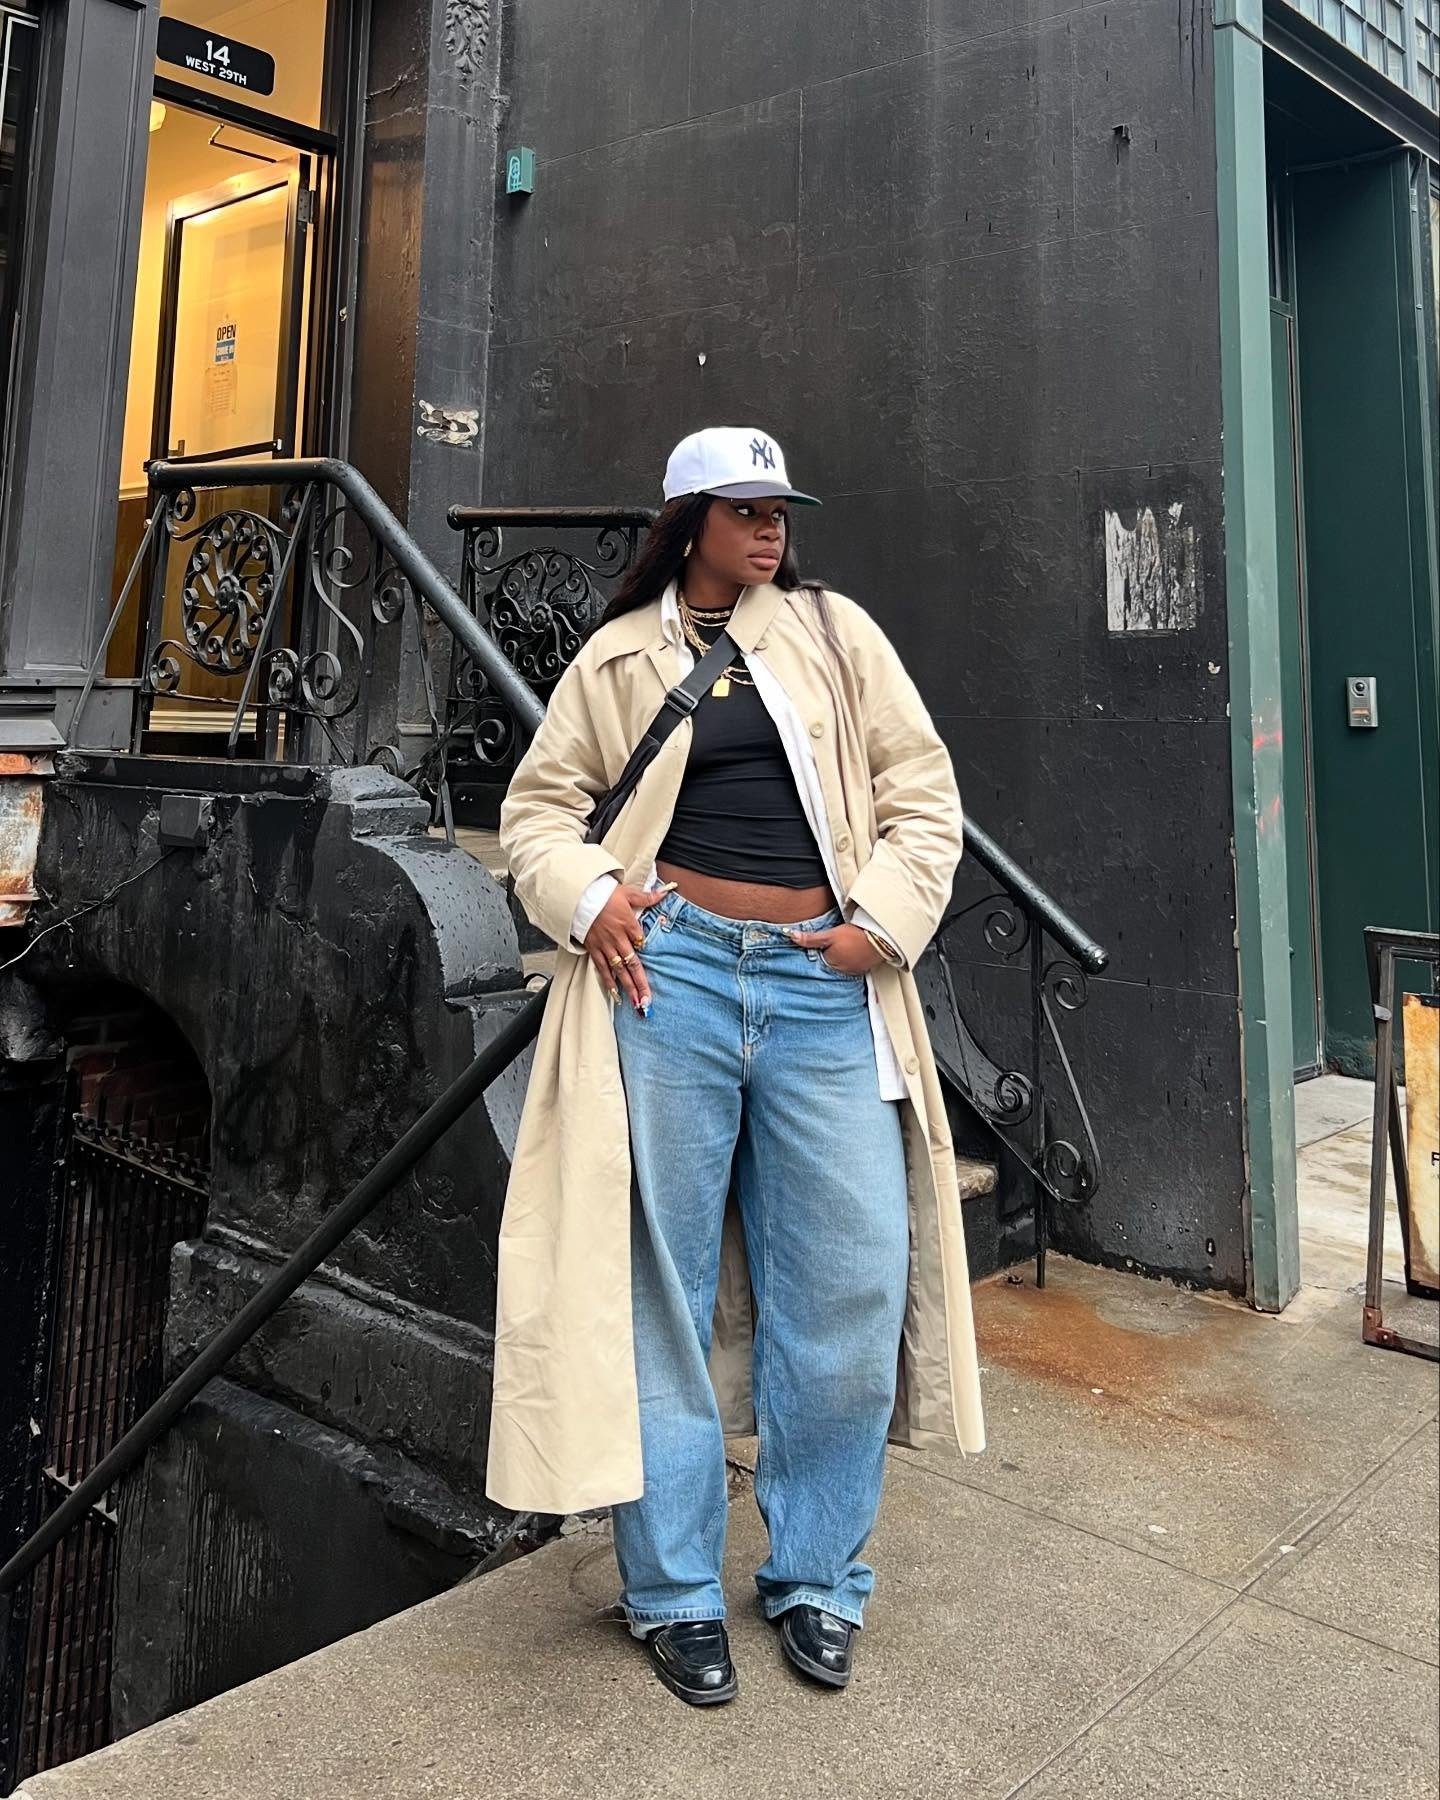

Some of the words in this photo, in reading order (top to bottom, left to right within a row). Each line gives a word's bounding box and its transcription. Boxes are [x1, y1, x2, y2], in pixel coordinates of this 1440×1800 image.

[206, 40, 230, 66] 14
[185, 55, 216, 74] WEST
[218, 67, 247, 86] 29TH
[216, 324, 237, 341] OPEN
[749, 437, 776, 470] NY
